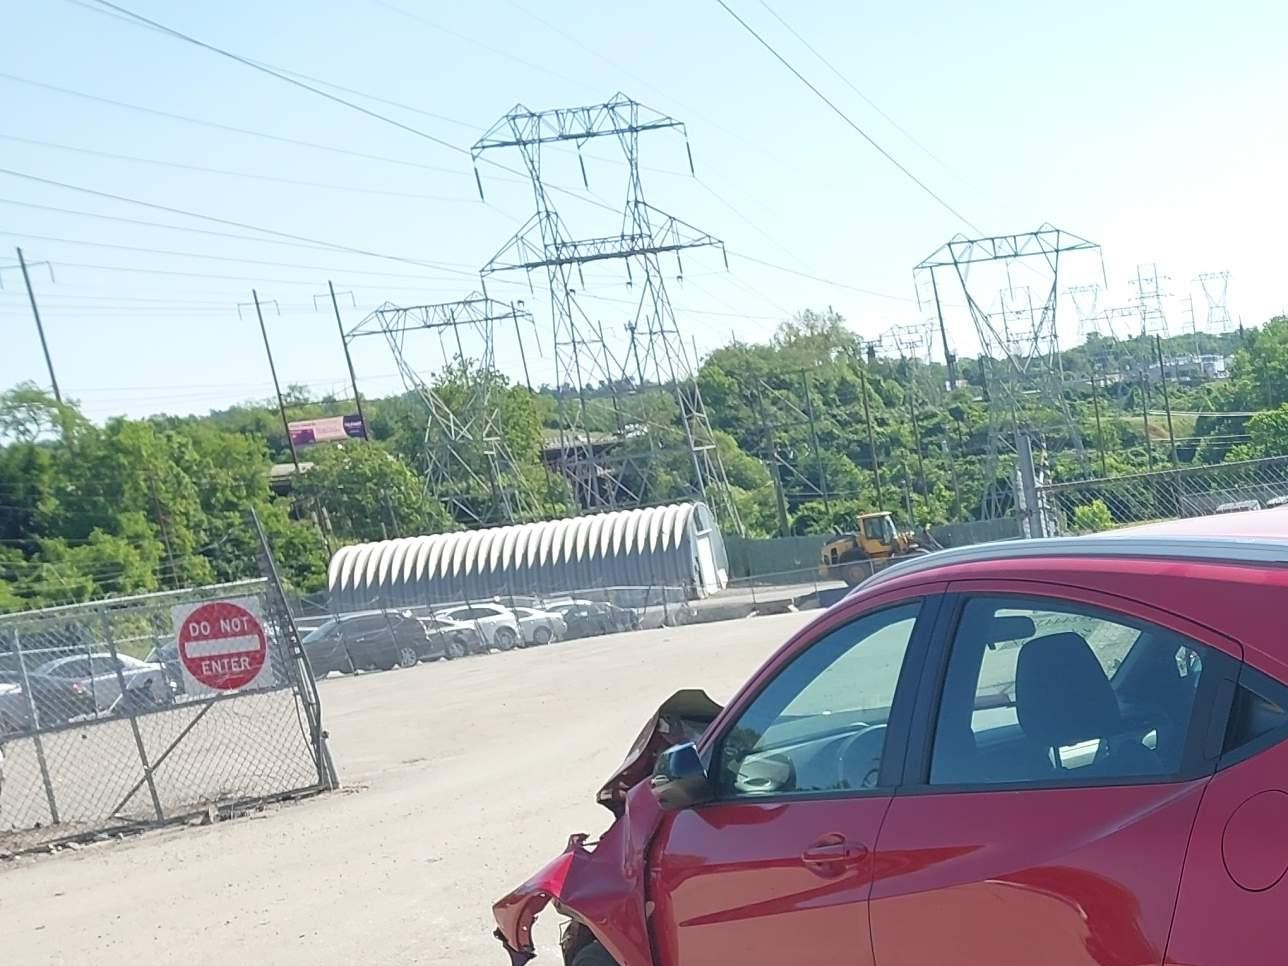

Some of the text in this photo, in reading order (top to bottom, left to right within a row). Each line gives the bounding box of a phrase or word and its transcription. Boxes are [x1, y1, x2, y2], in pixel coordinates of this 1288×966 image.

[189, 616, 249, 637] DO NOT
[201, 657, 251, 675] ENTER
